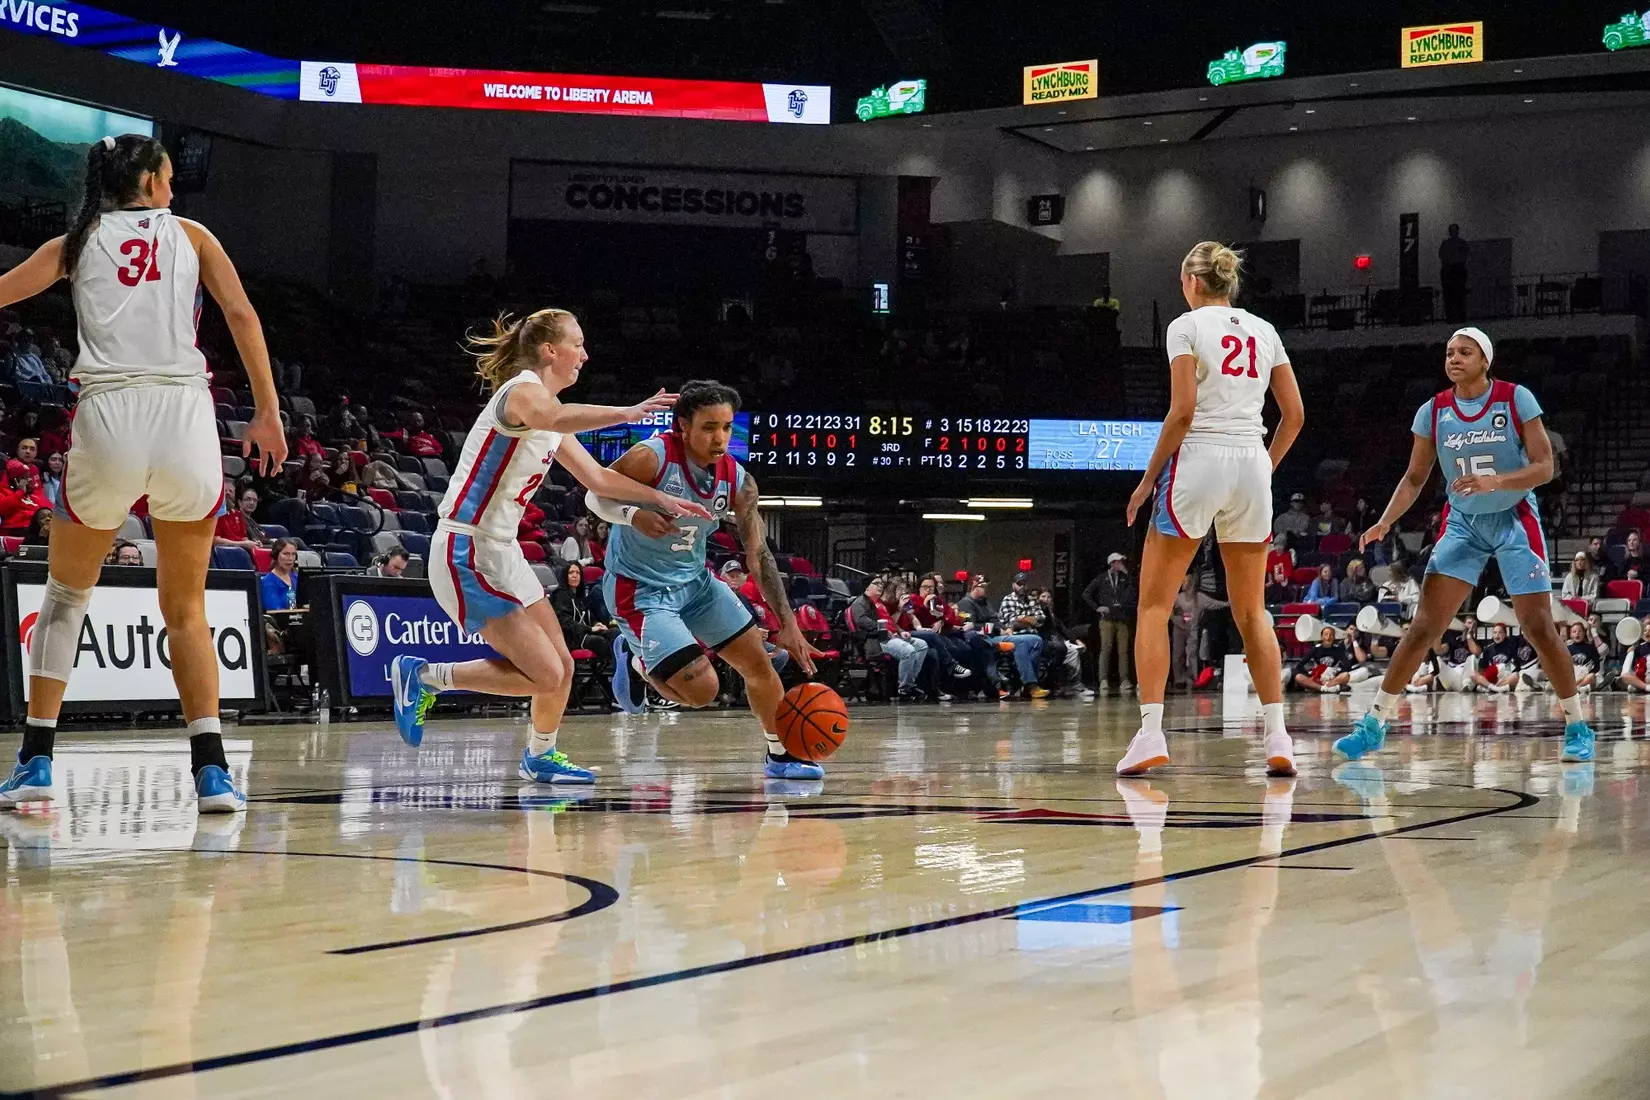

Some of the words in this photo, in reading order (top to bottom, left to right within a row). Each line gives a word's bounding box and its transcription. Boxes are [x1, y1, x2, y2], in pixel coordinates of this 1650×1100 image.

[1410, 33, 1473, 53] LYNCHBURG
[1410, 51, 1450, 64] READY
[1451, 49, 1473, 60] MIX
[1031, 71, 1089, 91] LYNCHBURG
[483, 83, 543, 100] WELCOME
[544, 86, 561, 101] TO
[562, 88, 610, 103] LIBERTY
[612, 90, 654, 106] ARENA
[1031, 88, 1067, 101] READY
[1068, 86, 1089, 97] MIX
[565, 184, 806, 219] CONCESSIONS
[117, 236, 162, 287] 31
[1221, 335, 1259, 379] 21
[768, 414, 778, 428] 0
[785, 415, 802, 429] 12
[805, 415, 822, 429] 21
[823, 416, 841, 430] 23
[844, 416, 860, 430] 31
[869, 416, 913, 436] 8:15
[940, 418, 949, 432] 3
[956, 419, 972, 432] 15
[975, 419, 991, 433] 18
[993, 419, 1010, 433] 22
[1011, 420, 1029, 434] 23
[1079, 422, 1099, 435] LA
[1101, 423, 1142, 436] TECH
[752, 434, 760, 444] F
[770, 432, 777, 447] 1
[790, 433, 797, 447] 1
[810, 434, 817, 448] 1
[827, 434, 837, 448] 0
[848, 434, 856, 449] 1
[881, 443, 901, 452] 3RD
[925, 437, 933, 448] F
[939, 436, 949, 450] 2
[961, 437, 968, 450] 1
[977, 437, 987, 451] 0
[996, 437, 1006, 451] 0
[1015, 438, 1025, 452] 2
[1096, 438, 1125, 459] 27
[749, 452, 764, 462] PT
[767, 451, 777, 465] 2
[785, 451, 801, 465] 11
[807, 452, 817, 466] 3
[827, 452, 836, 466] 9
[846, 452, 855, 466] 2
[880, 456, 892, 466] 30
[898, 456, 905, 466] F
[906, 457, 911, 466] 1
[920, 456, 936, 466] PT
[936, 454, 953, 468] 13
[958, 455, 968, 468] 2
[977, 455, 986, 469] 2
[996, 455, 1005, 469] 5
[1015, 456, 1024, 469] 3
[670, 525, 699, 552] 3
[1055, 551, 1069, 589] MEN
[384, 612, 452, 645] Carter
[73, 613, 248, 671] Auta
